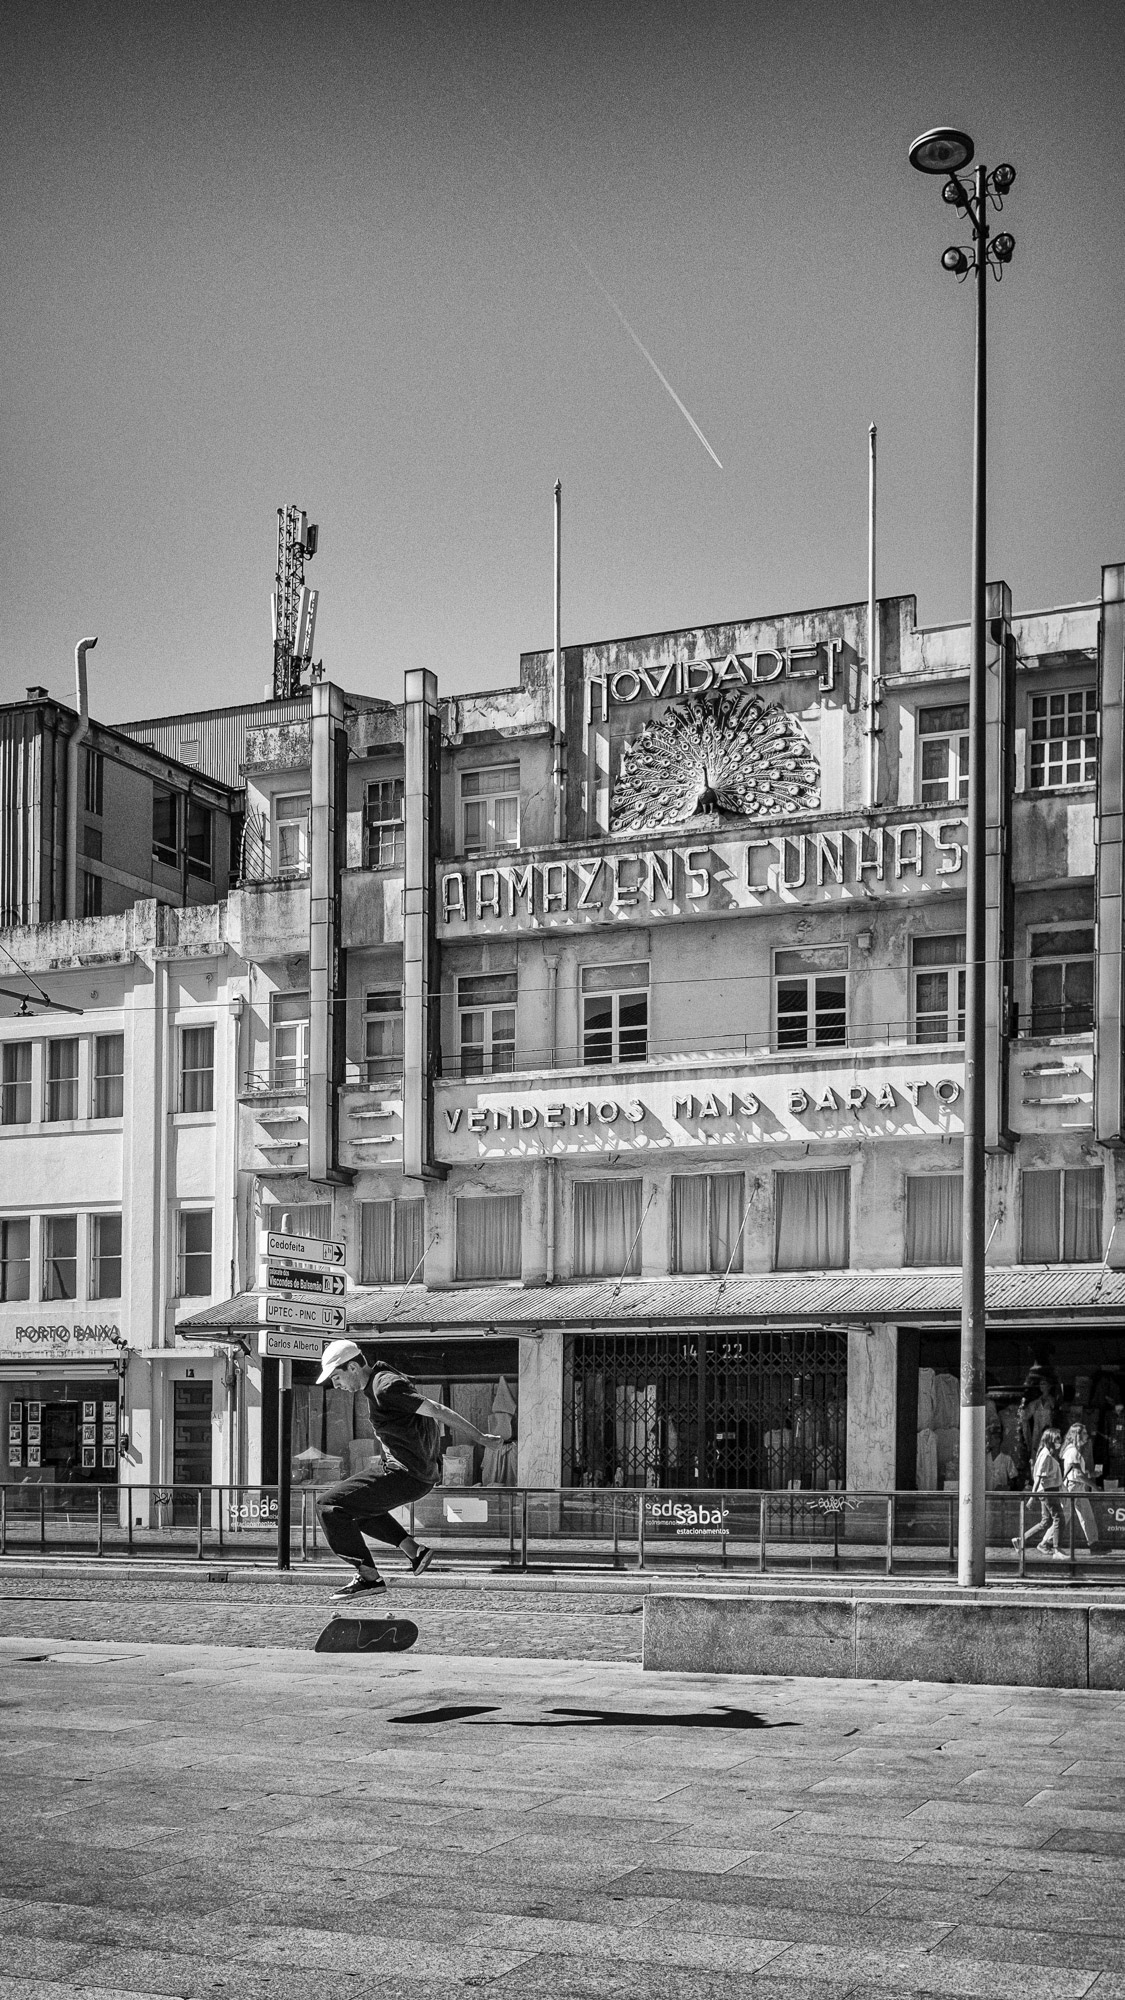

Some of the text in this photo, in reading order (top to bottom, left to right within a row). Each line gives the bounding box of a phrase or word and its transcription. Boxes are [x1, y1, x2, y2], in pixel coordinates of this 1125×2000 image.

[585, 637, 843, 724] NOVIDADES
[441, 819, 963, 923] ARMAZENS CUNHAS
[442, 1078, 960, 1133] VENDEMOS MAIS BARATO
[269, 1238, 305, 1252] Cedofeita
[269, 1275, 323, 1291] Viscondes de Balsemão
[268, 1305, 293, 1318] UPTEC
[299, 1309, 317, 1321] PINC
[15, 1324, 120, 1341] PORTO BAIXA
[268, 1337, 319, 1351] Carlos Alberto
[683, 1344, 697, 1359] 14
[722, 1343, 743, 1359] 22
